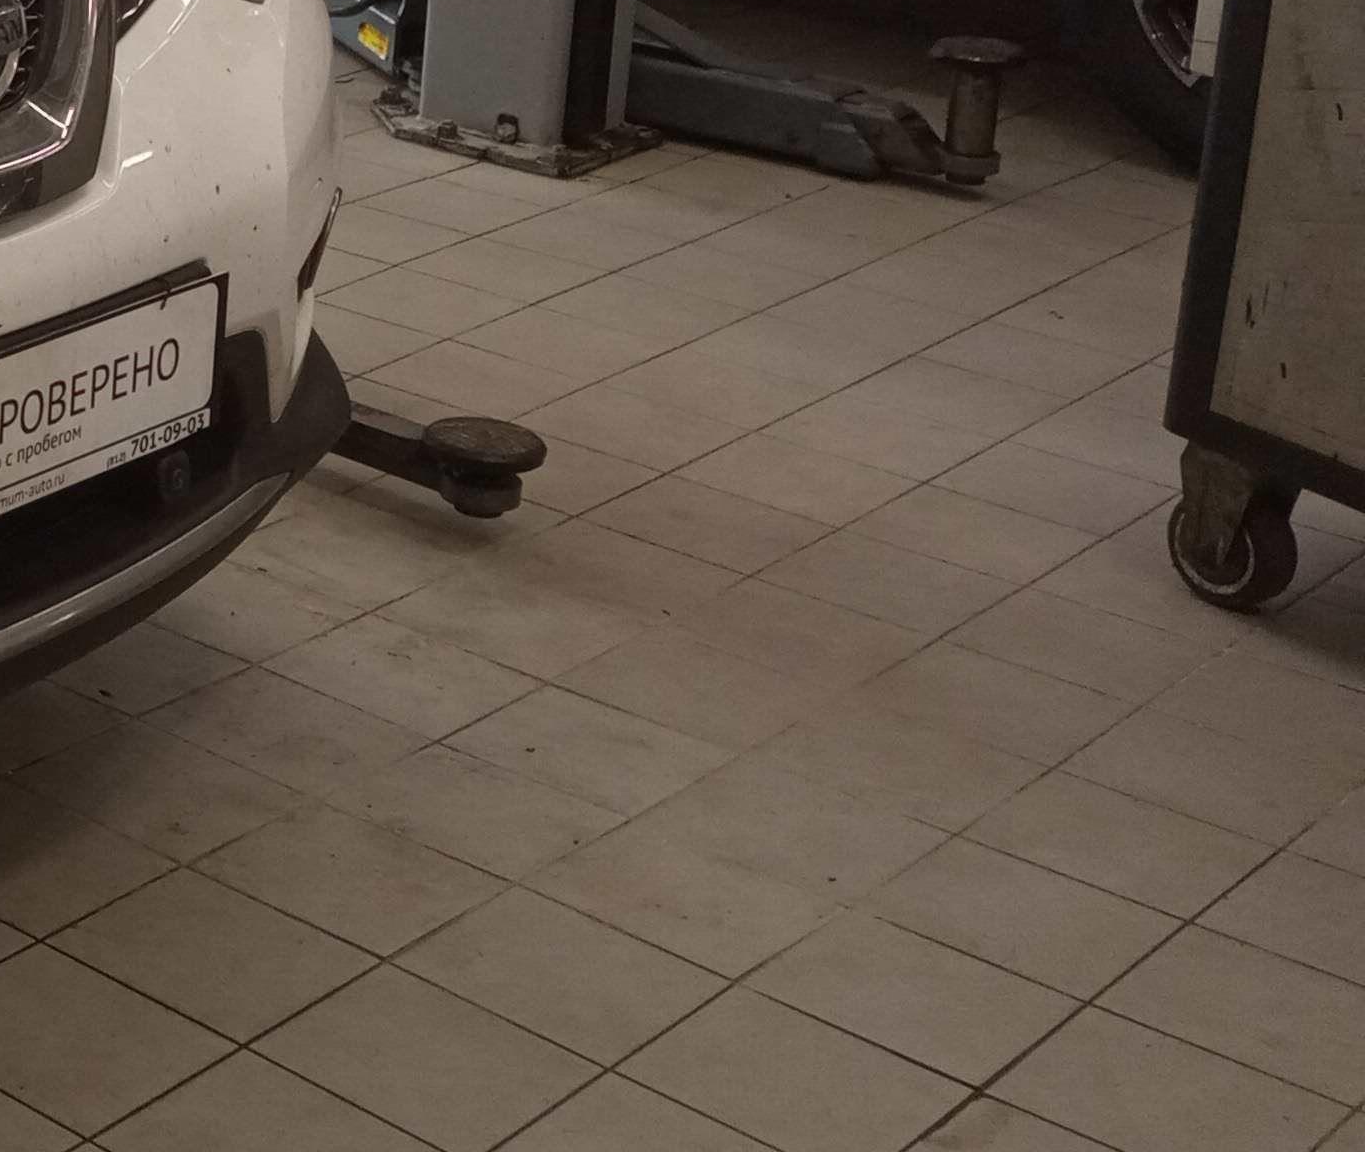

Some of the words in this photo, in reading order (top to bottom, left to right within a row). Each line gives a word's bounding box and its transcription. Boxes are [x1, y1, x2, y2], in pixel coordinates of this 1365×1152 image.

[4, 450, 14, 468] с
[16, 425, 83, 465] пробегом
[130, 412, 206, 458] 701-09-03
